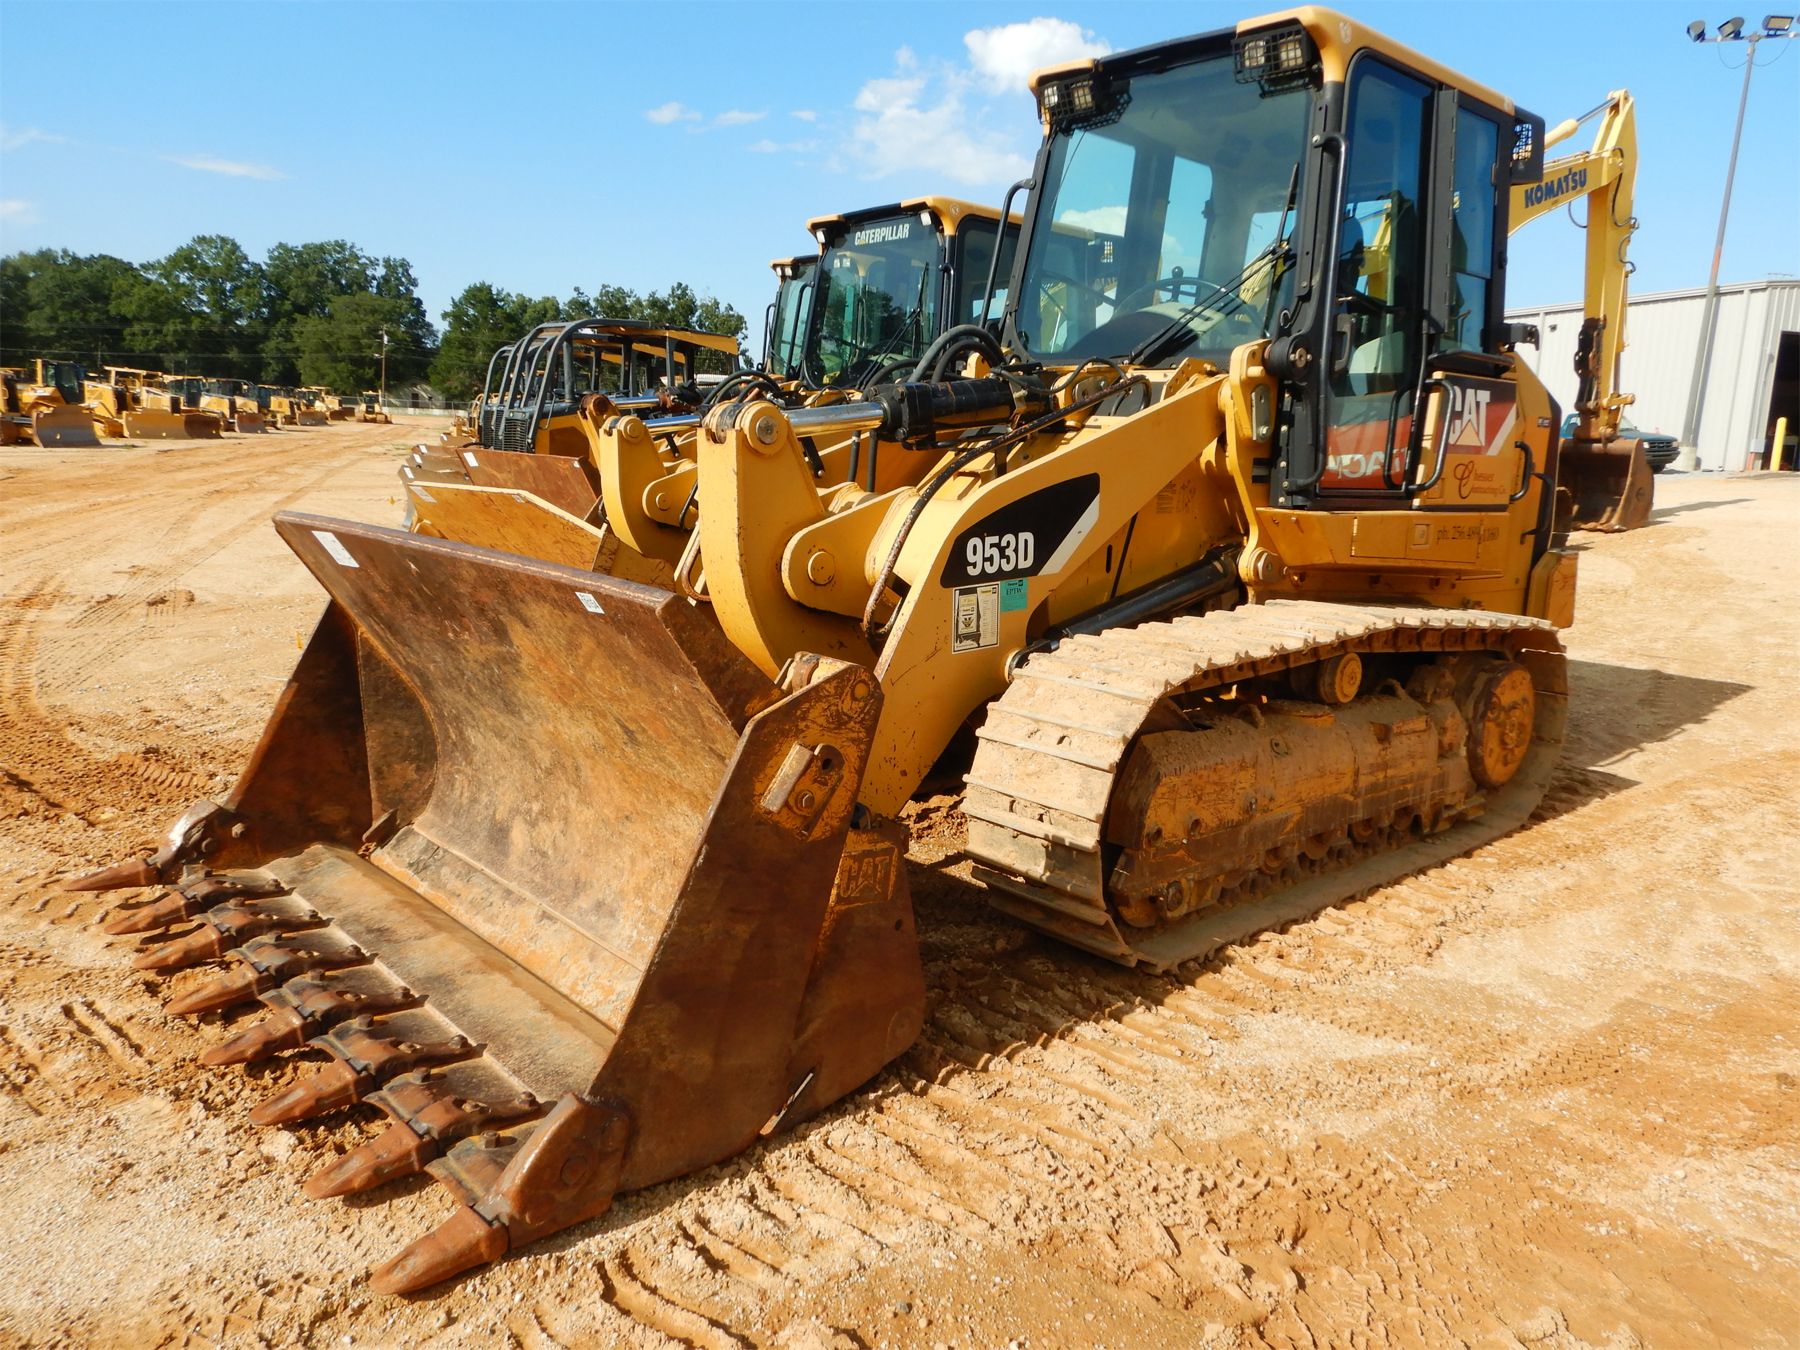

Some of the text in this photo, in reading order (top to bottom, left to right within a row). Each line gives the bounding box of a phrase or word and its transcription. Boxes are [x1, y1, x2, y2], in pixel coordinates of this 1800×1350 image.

[1524, 168, 1588, 208] KOMATSU
[854, 223, 910, 246] CATERPILLAR
[1447, 385, 1491, 447] CAT
[966, 531, 1035, 576] 953D
[839, 855, 890, 897] CAT
